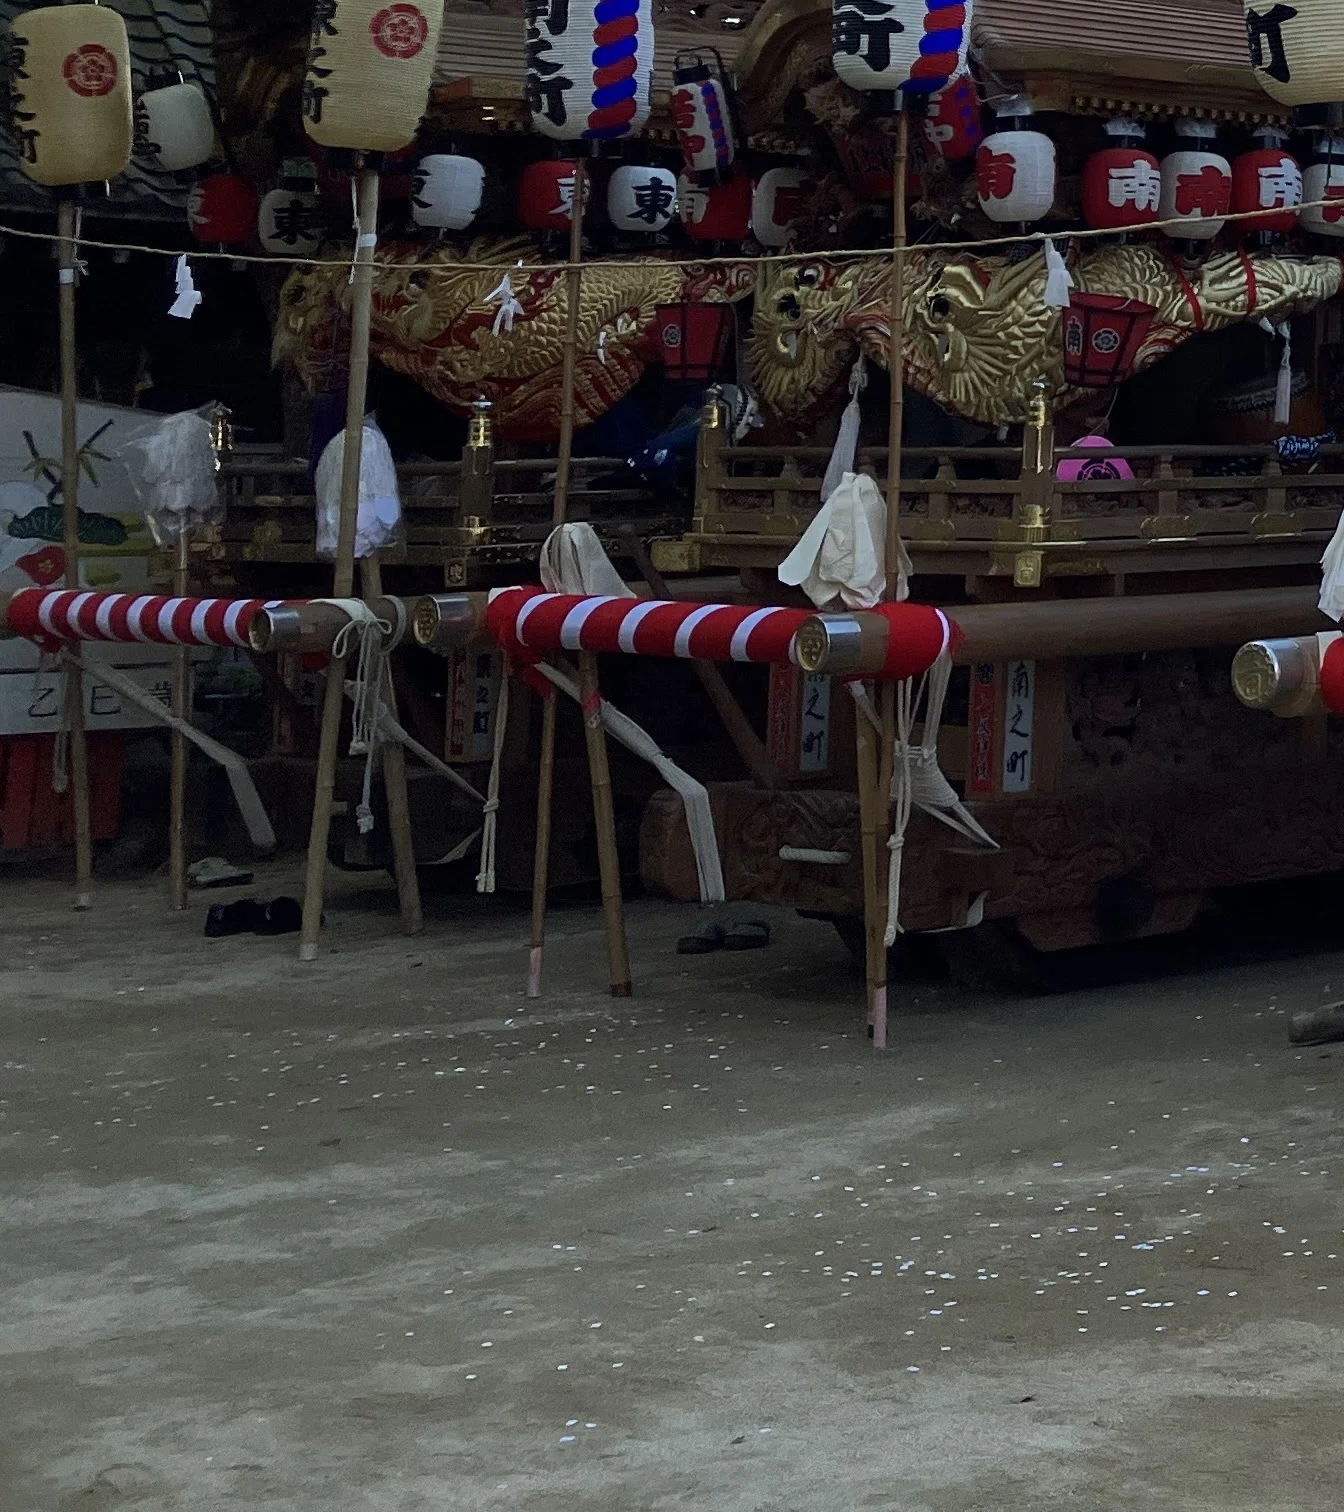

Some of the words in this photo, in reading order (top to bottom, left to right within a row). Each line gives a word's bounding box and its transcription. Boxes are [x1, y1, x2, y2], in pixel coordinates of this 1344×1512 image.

[627, 176, 675, 224] 東
[1107, 158, 1161, 213] 南
[268, 198, 317, 246] 東
[803, 668, 826, 762] 之町
[1006, 660, 1031, 783] 南之町
